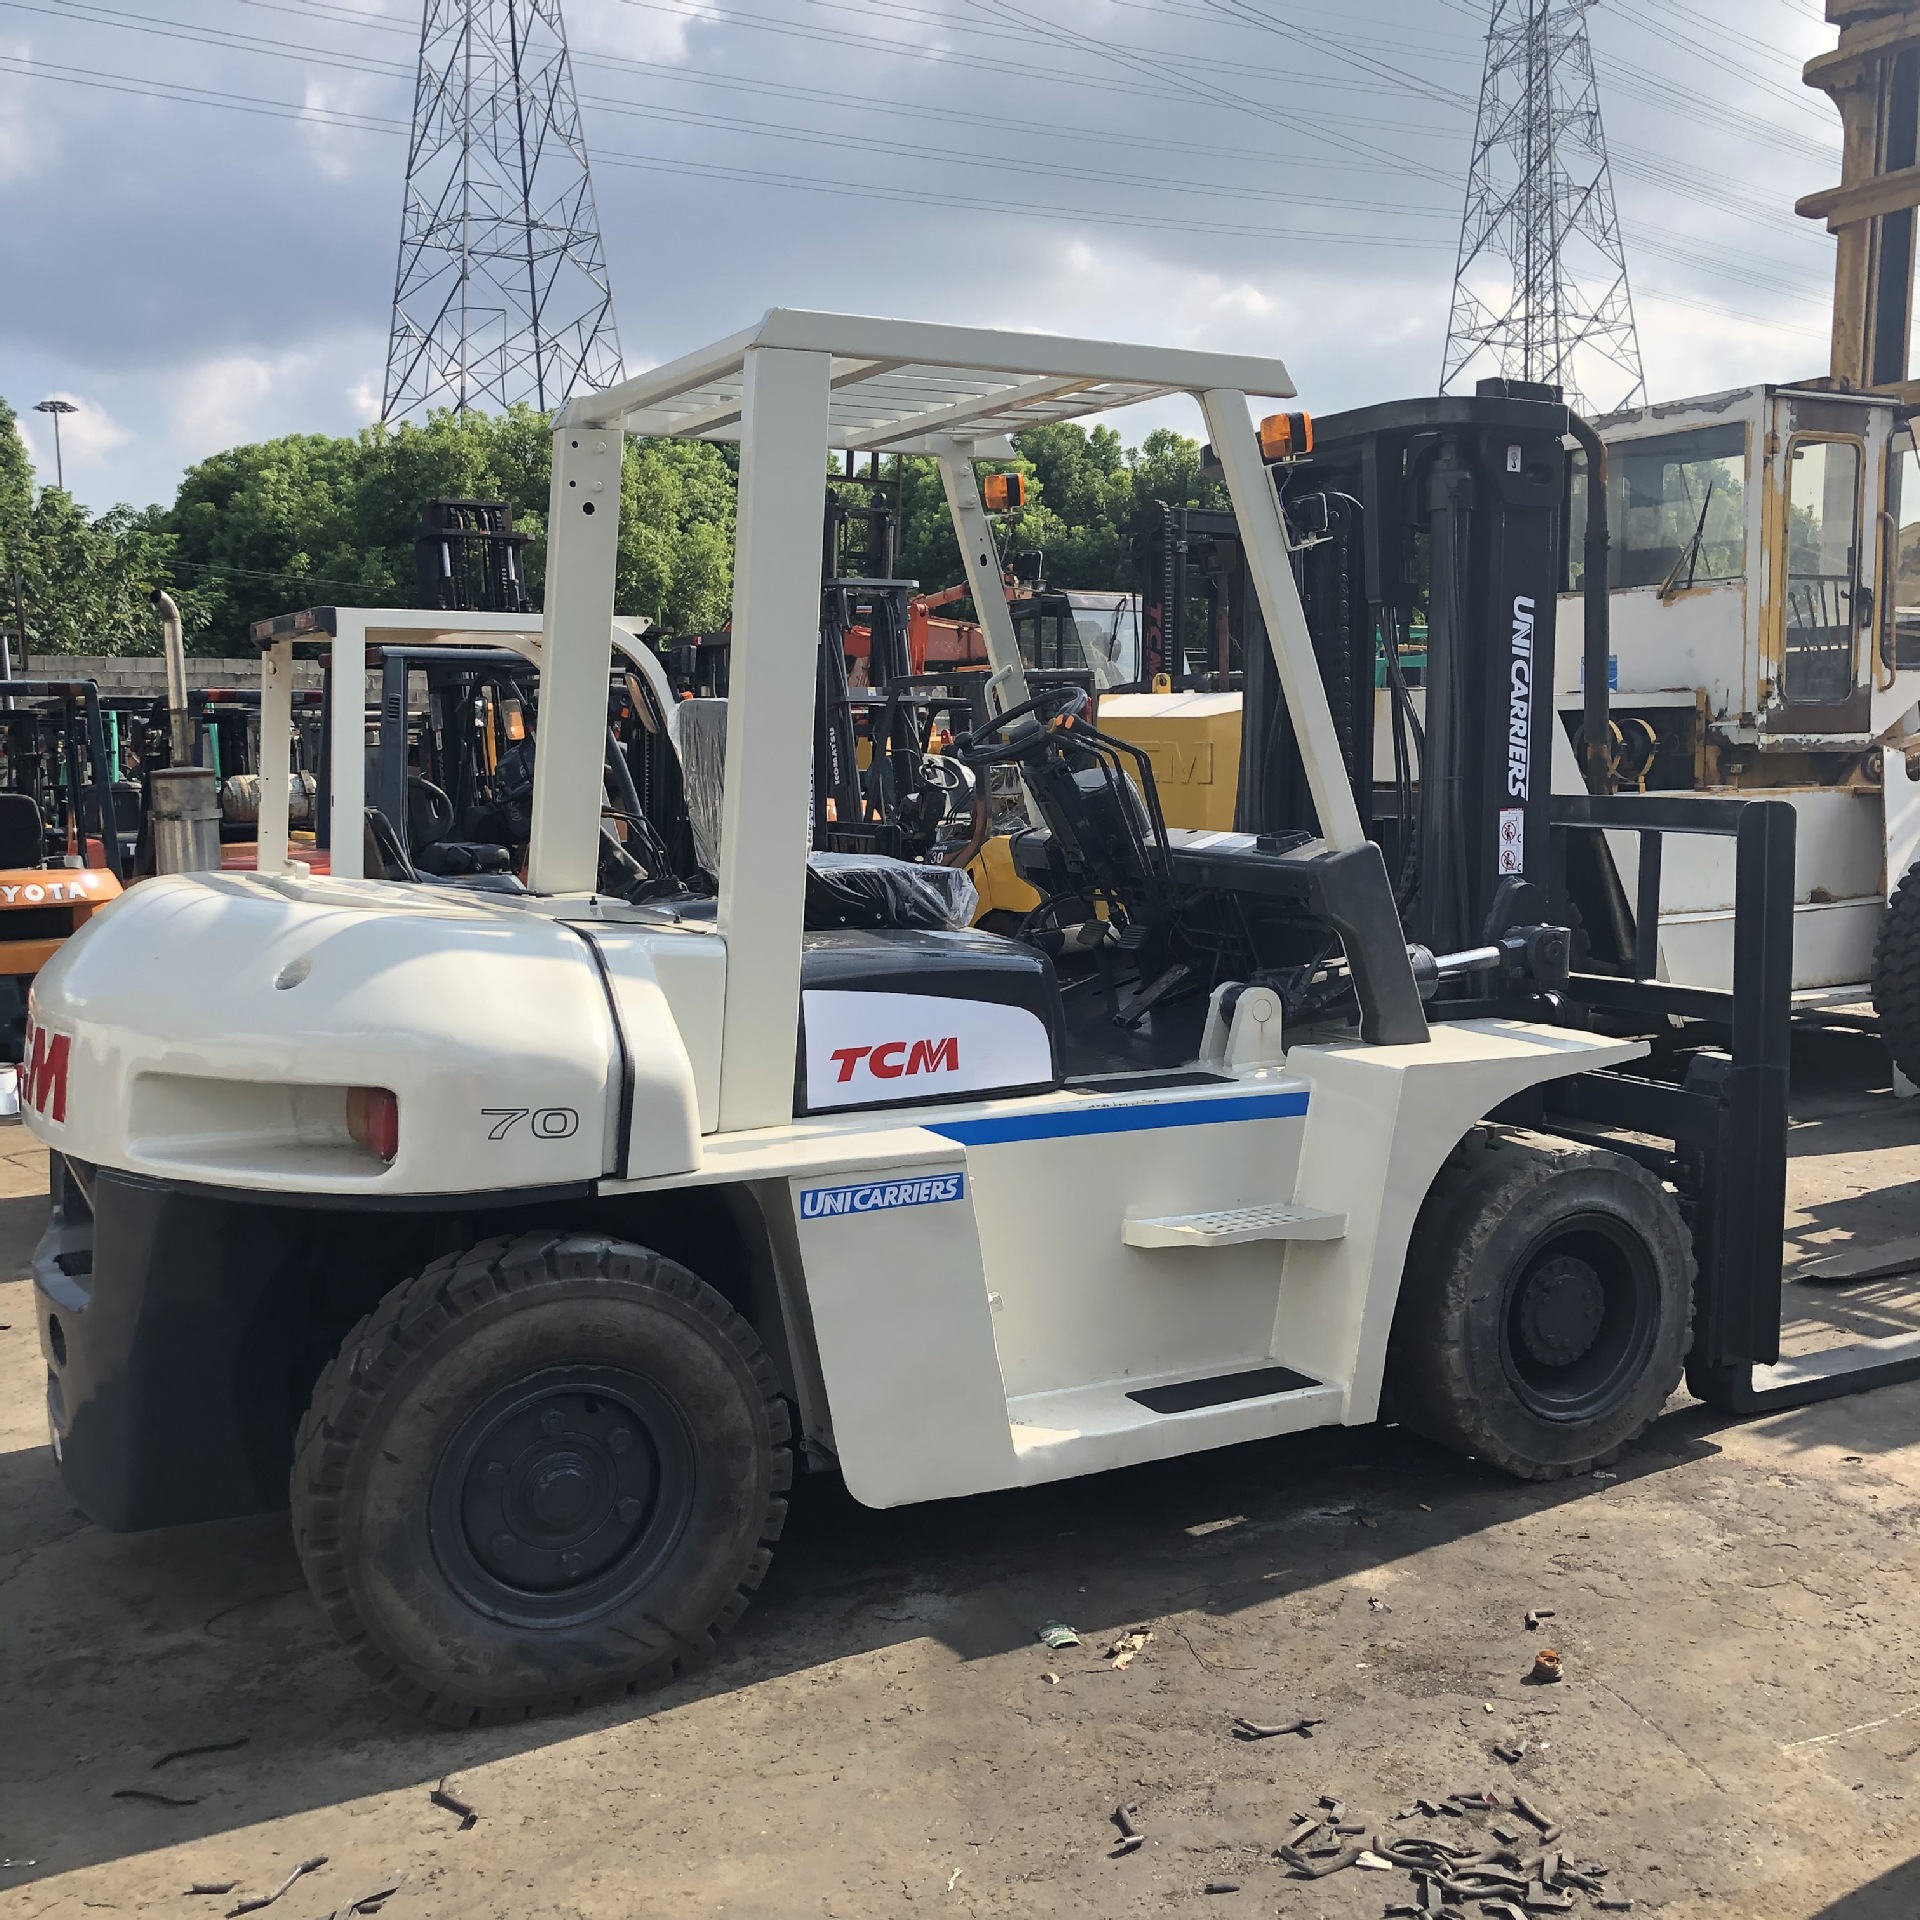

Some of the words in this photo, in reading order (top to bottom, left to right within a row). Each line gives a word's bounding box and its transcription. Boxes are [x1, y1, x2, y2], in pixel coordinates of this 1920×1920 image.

[829, 727, 841, 786] KOMATSU
[930, 851, 944, 864] 30
[829, 1037, 960, 1083] TCM
[481, 1107, 579, 1140] 70
